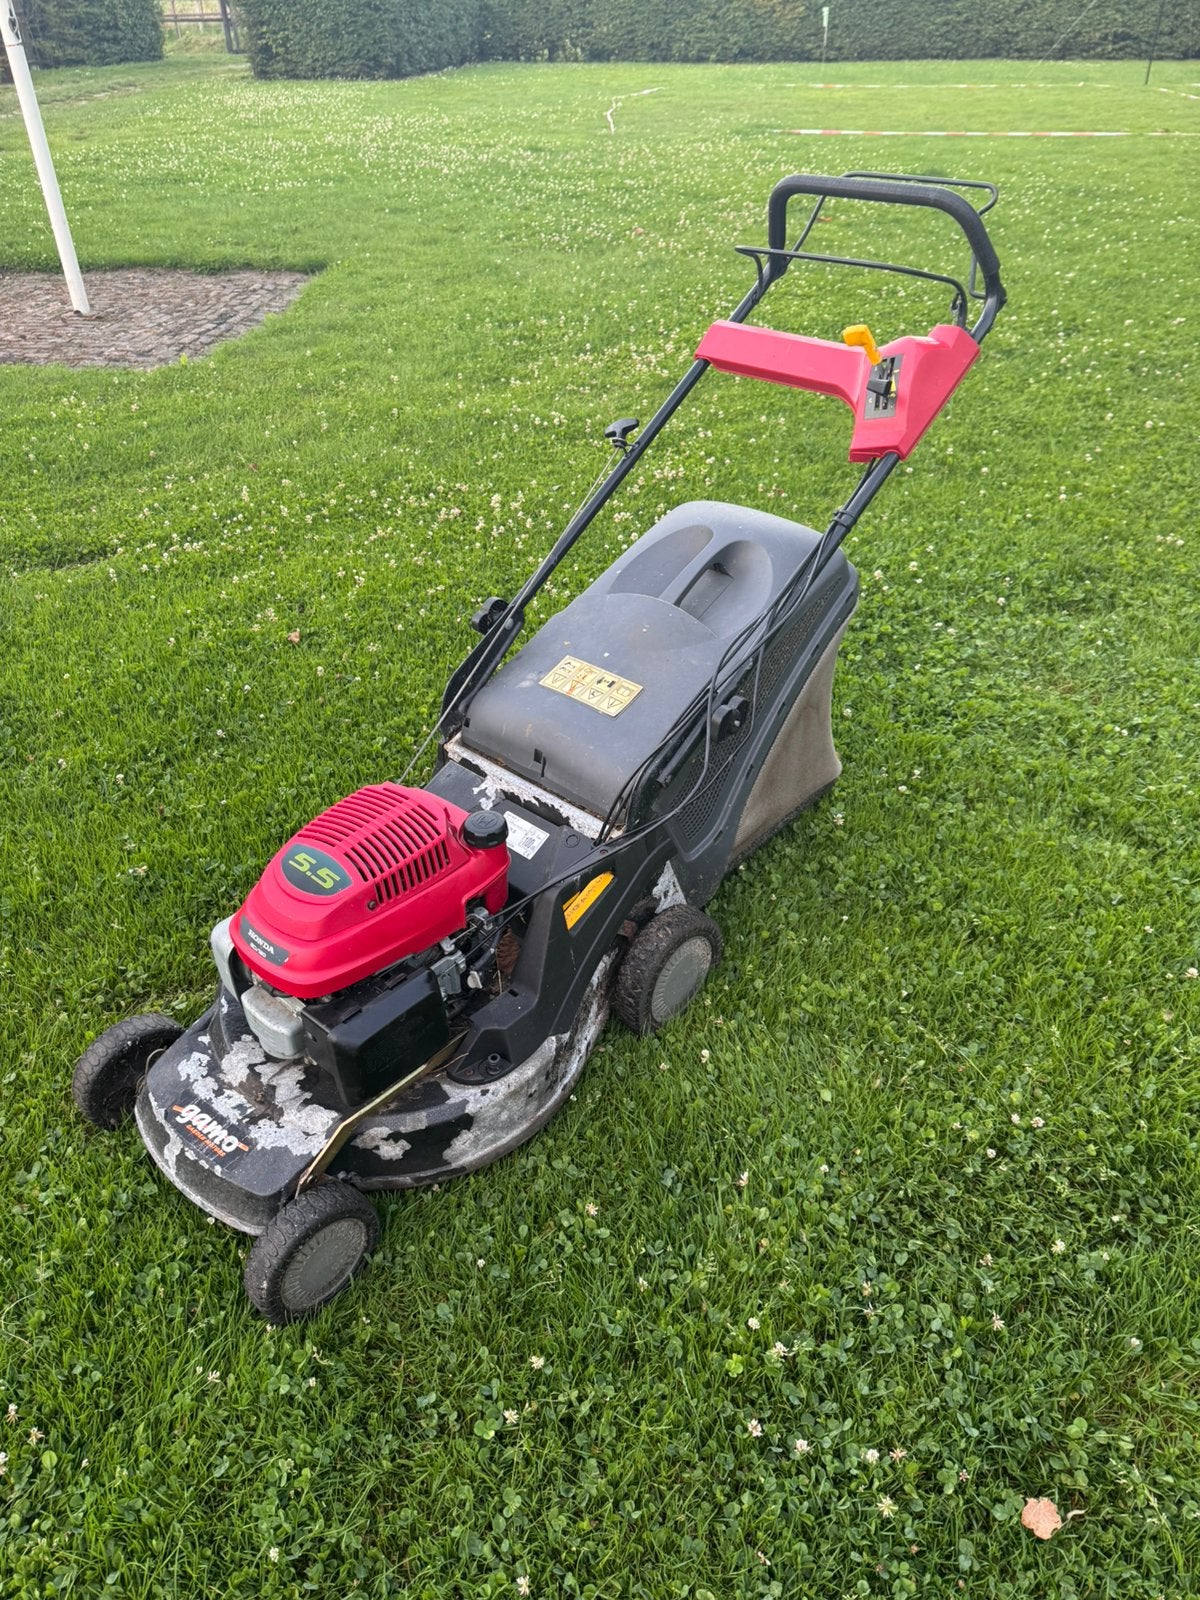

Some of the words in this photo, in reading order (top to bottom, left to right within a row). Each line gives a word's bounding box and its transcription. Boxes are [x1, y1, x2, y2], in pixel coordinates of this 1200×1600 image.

[288, 852, 341, 889] 5.5
[248, 929, 275, 955] HONDA
[175, 1104, 239, 1153] gamo
